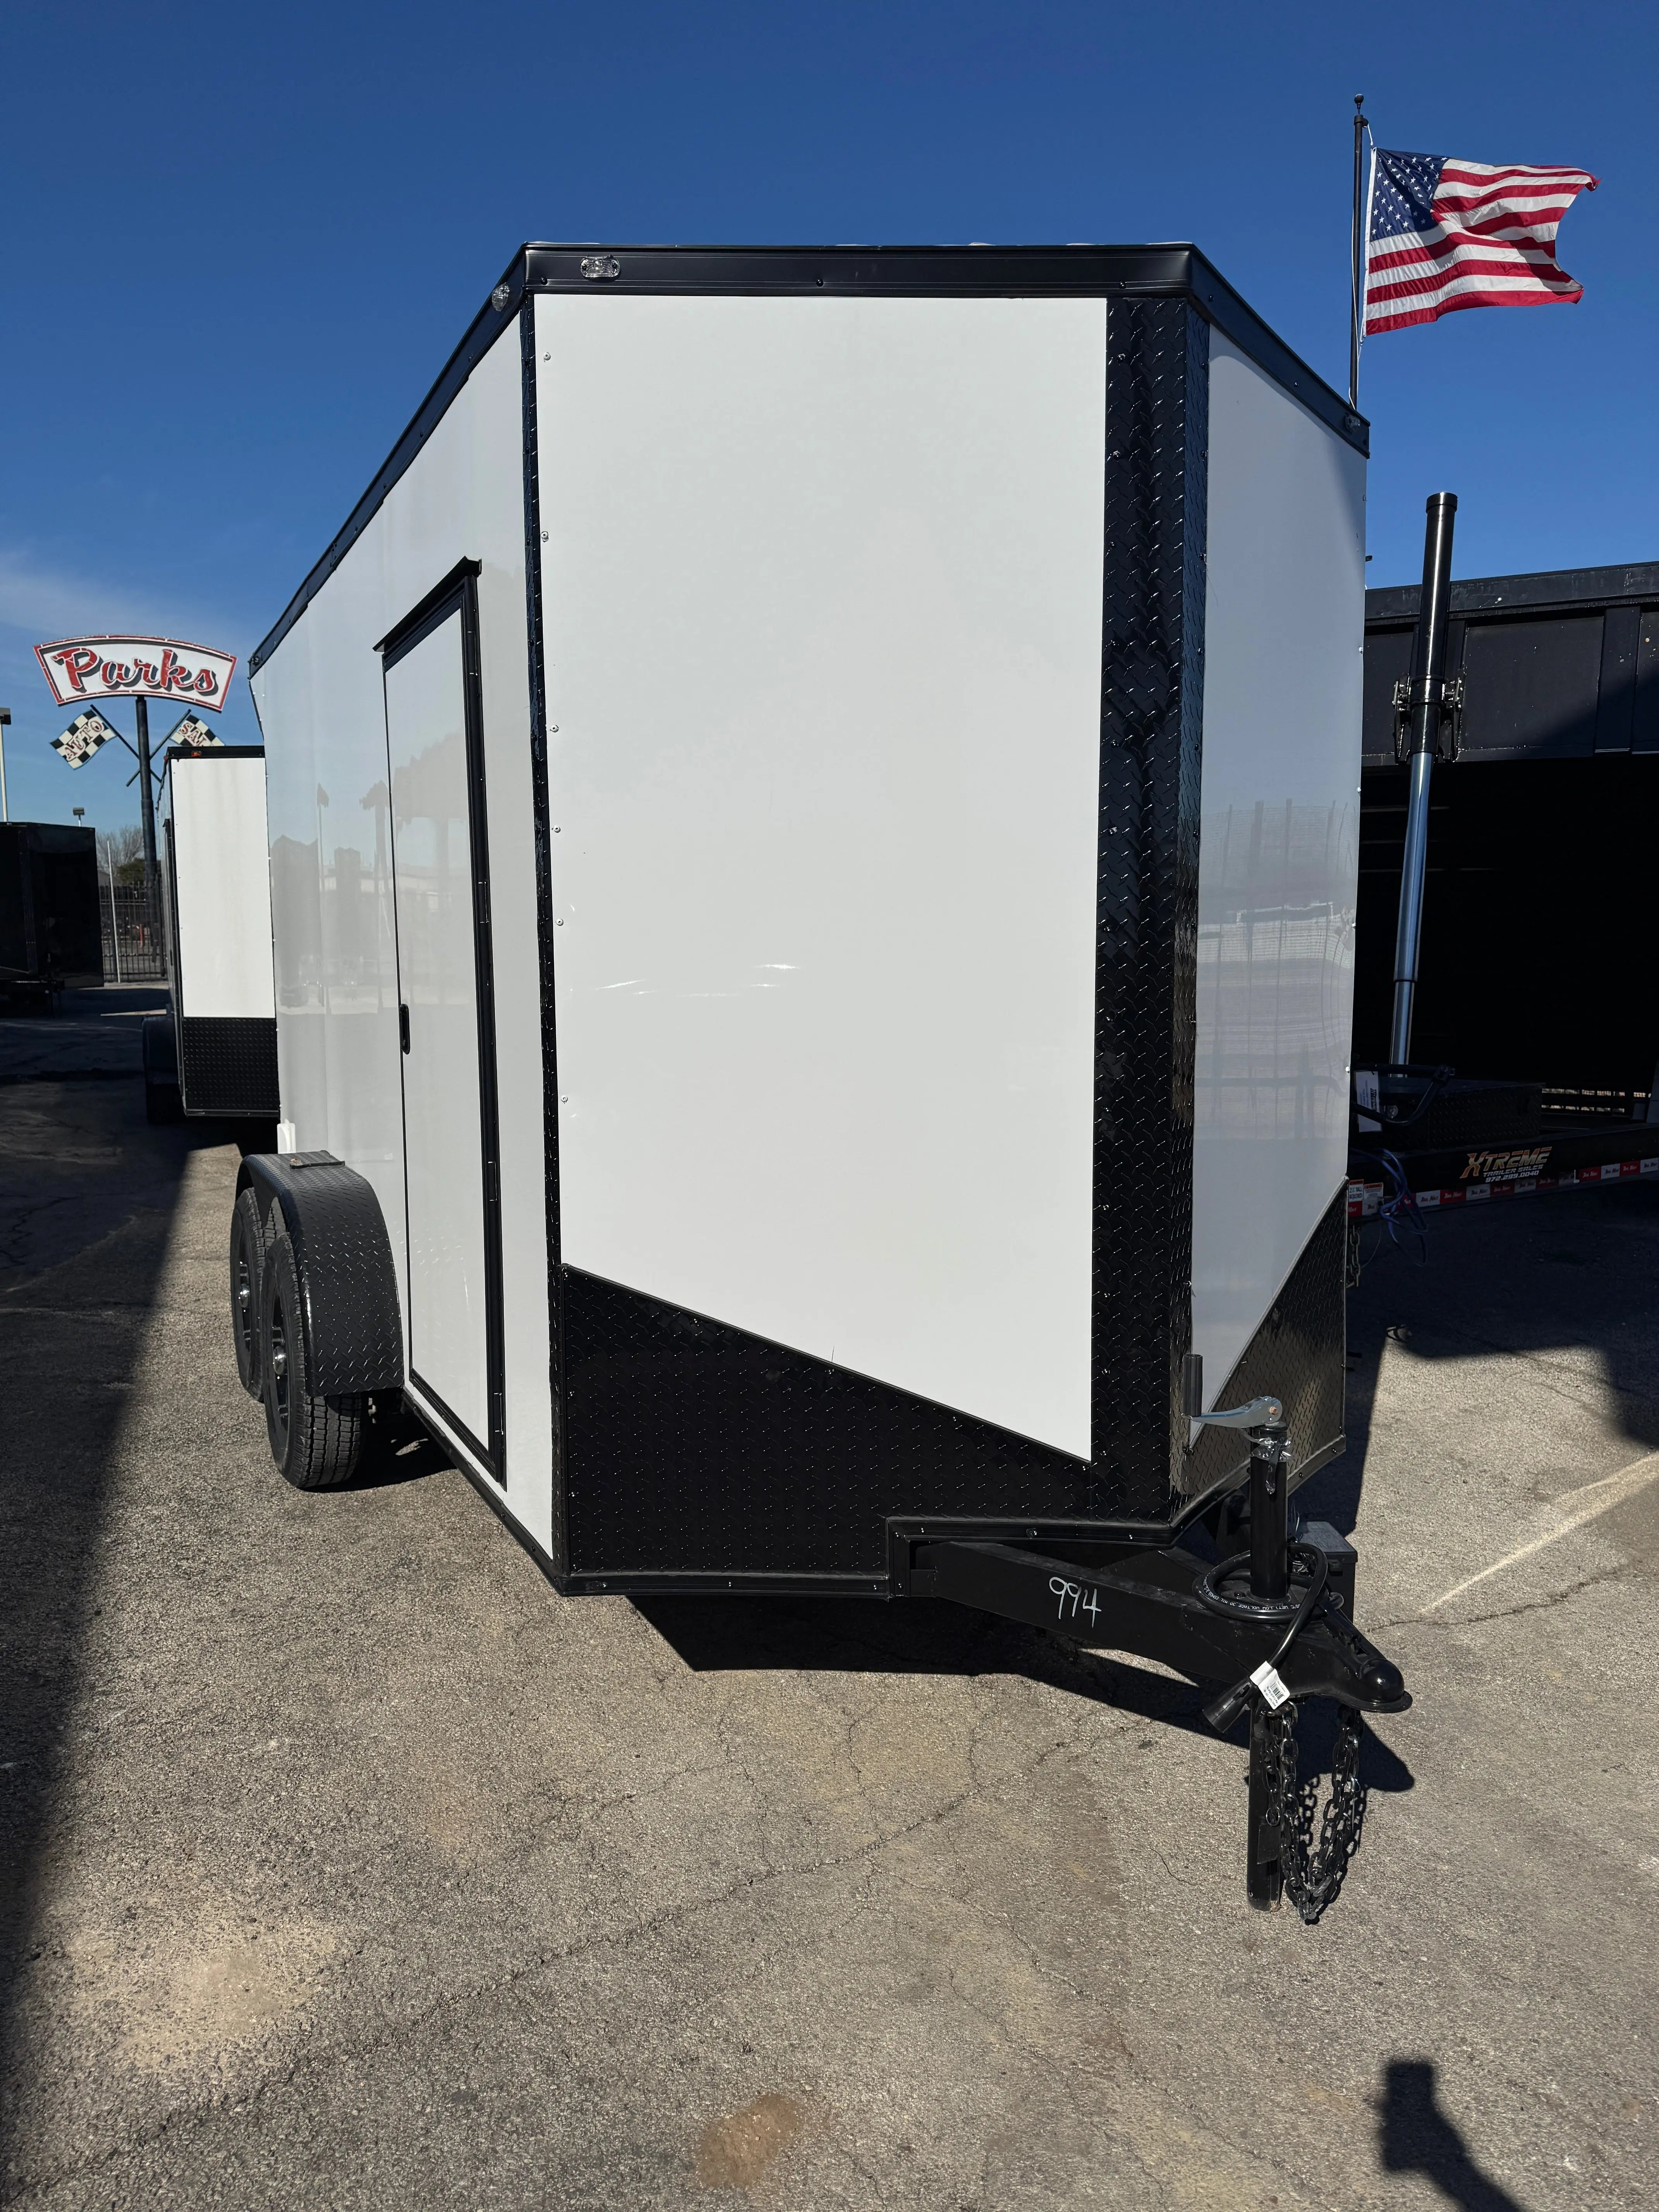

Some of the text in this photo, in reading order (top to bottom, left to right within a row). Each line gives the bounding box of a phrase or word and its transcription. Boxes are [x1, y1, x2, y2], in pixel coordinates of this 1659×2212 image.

[51, 647, 217, 693] Parks
[64, 720, 103, 759] AUTO
[179, 723, 208, 746] SAL
[1459, 1146, 1553, 1179] XTREME
[1483, 1164, 1544, 1177] TRAILER SALES
[1049, 1577, 1102, 1628] 994
